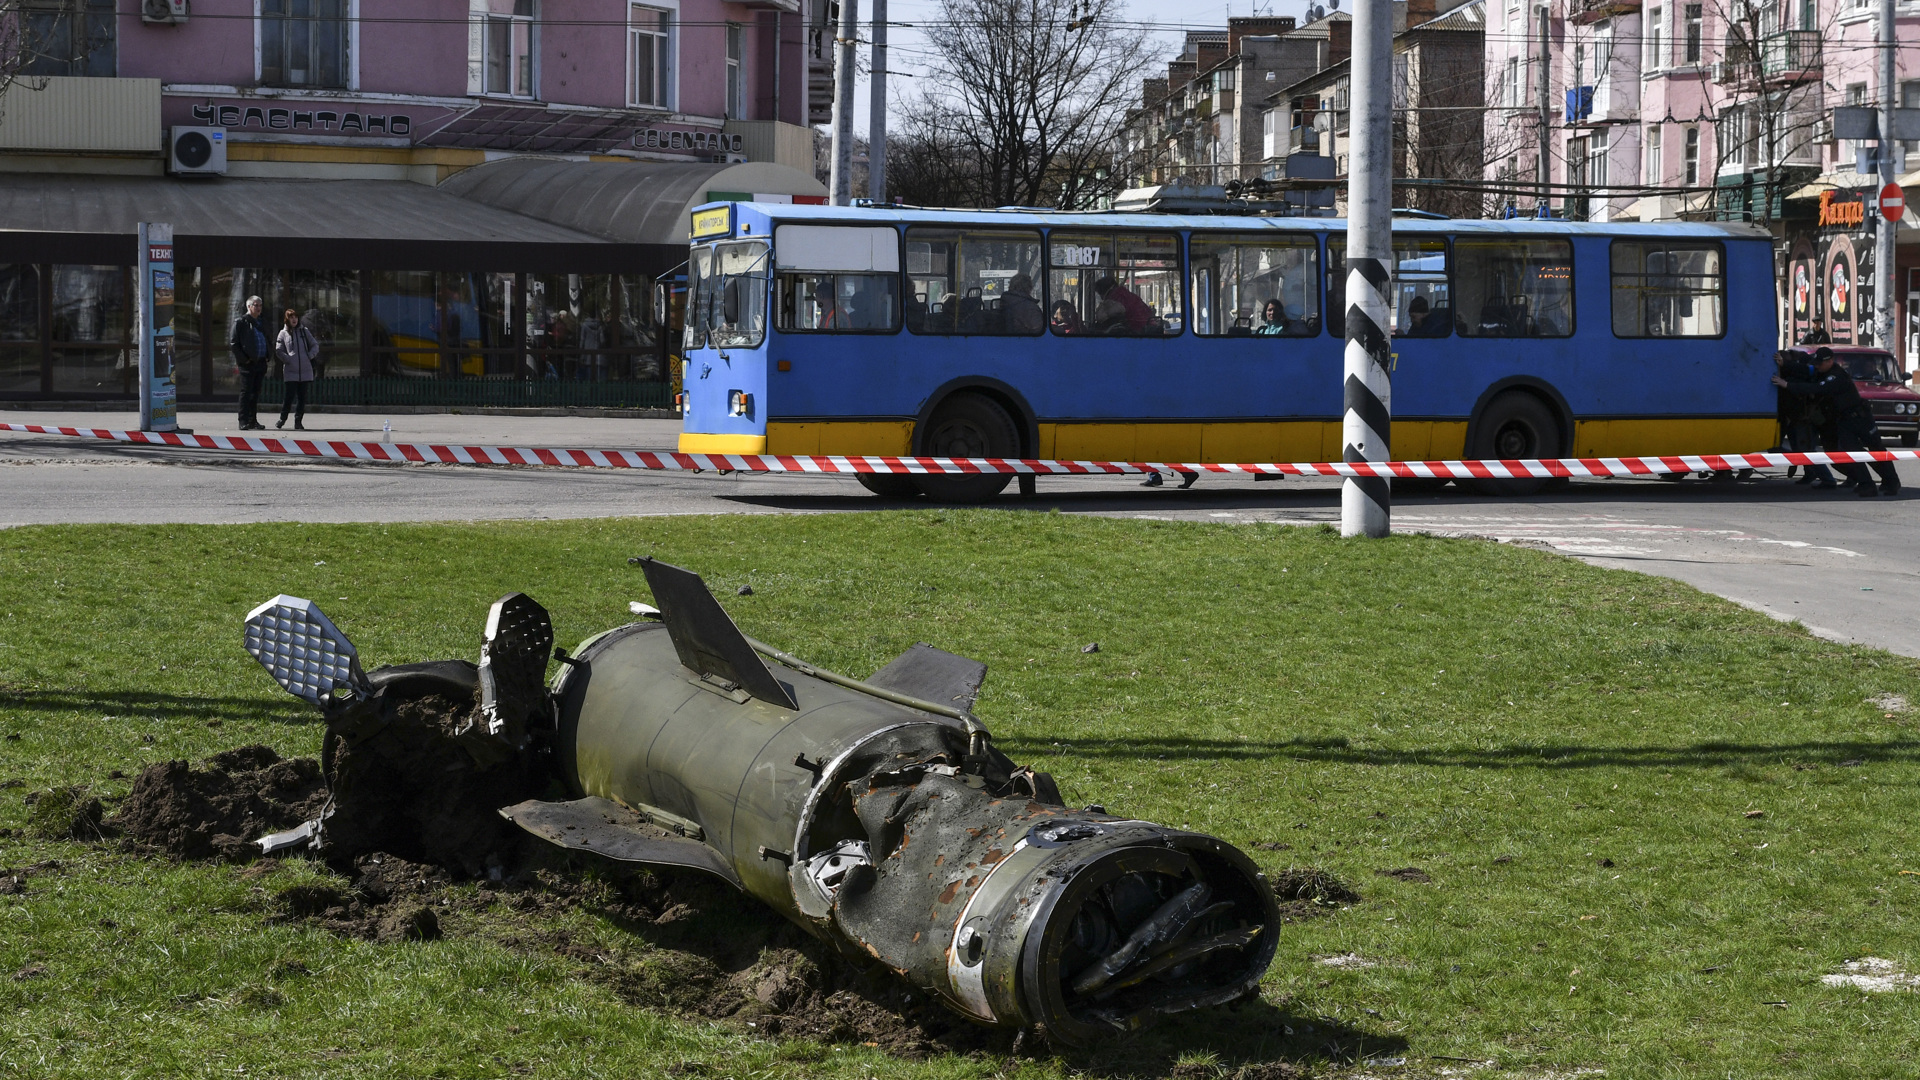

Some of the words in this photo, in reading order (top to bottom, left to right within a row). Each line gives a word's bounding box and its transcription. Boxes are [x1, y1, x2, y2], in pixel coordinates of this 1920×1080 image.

[192, 104, 411, 136] ЧЕЛЕНТАНО
[633, 128, 743, 152] CELENTANO
[1066, 246, 1100, 266] 0187
